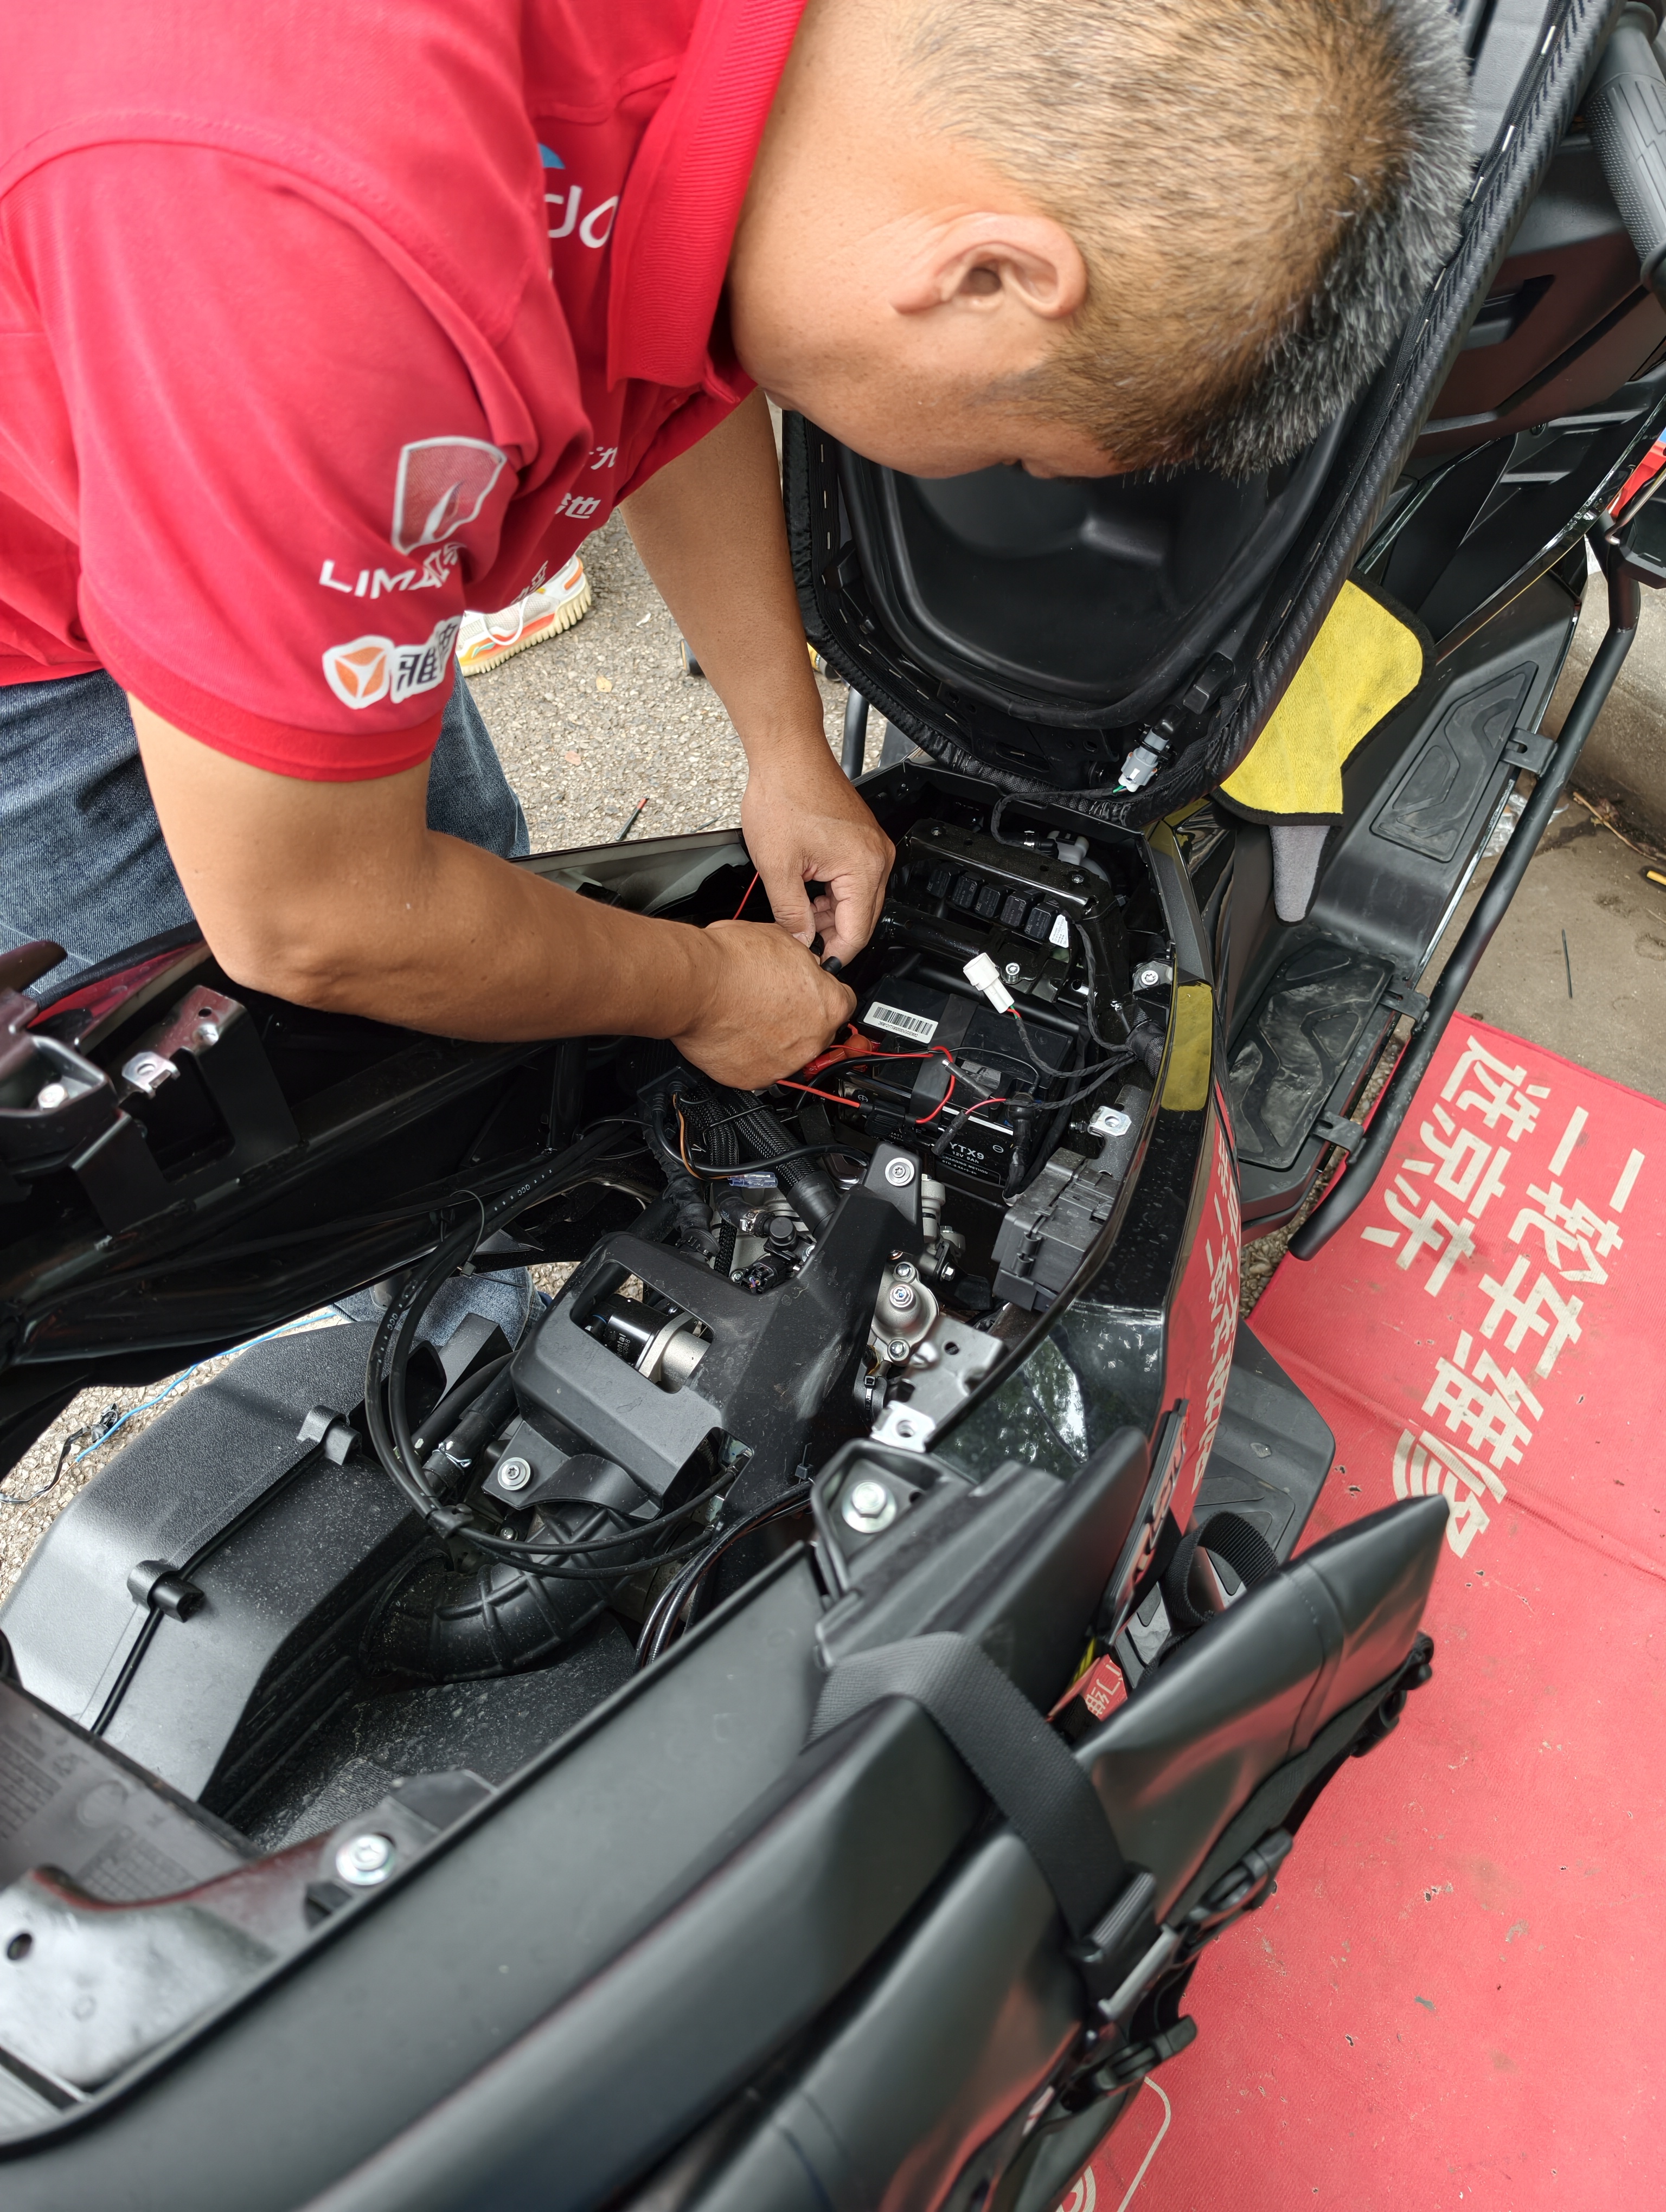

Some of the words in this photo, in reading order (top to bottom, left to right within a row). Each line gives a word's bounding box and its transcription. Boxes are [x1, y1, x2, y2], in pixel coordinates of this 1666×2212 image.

[942, 1155, 967, 1166] CHARGING
[968, 1165, 988, 1174] METHOD
[949, 1141, 984, 1160] YTX9
[1361, 1034, 1551, 1297] 选京东
[1392, 1106, 1645, 1559] 二轮车维修
